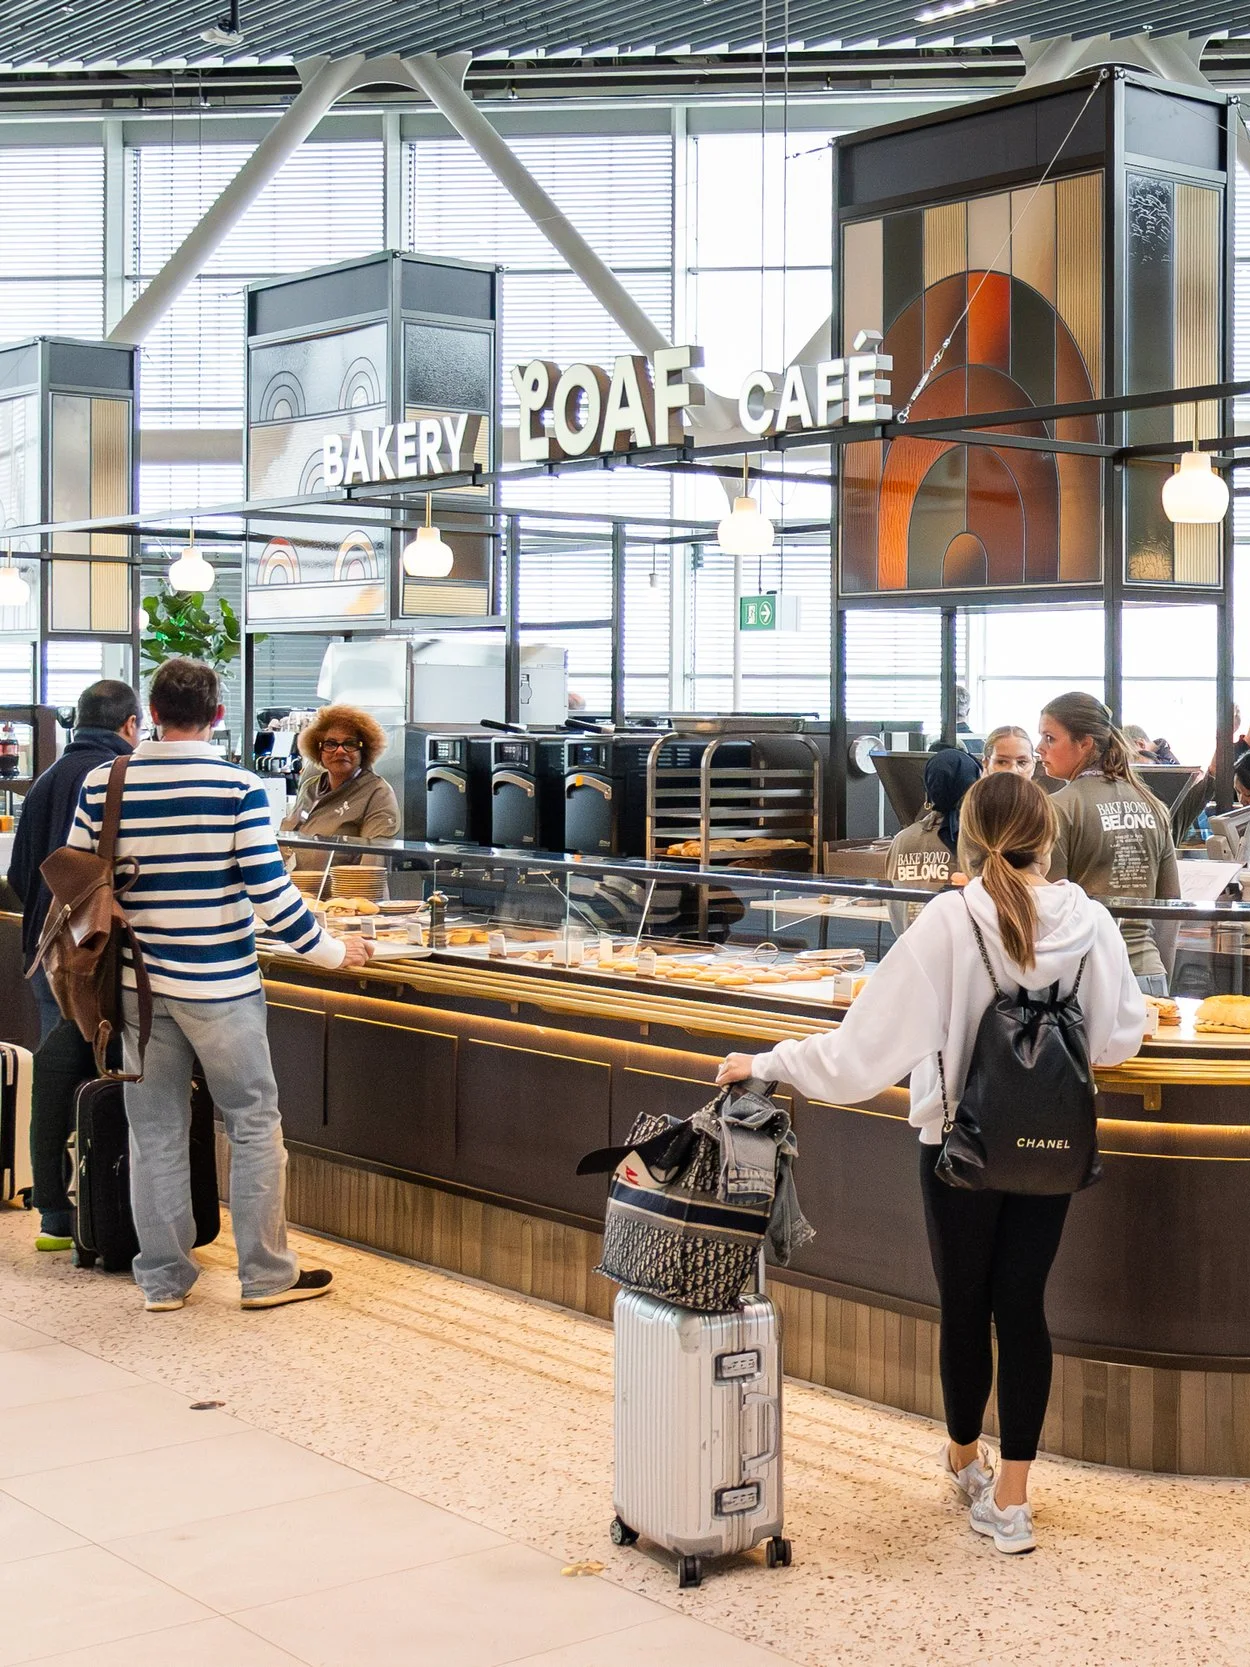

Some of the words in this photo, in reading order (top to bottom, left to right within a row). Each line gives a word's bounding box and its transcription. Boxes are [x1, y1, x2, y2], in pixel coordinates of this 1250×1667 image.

[323, 413, 473, 487] BAKERY
[512, 345, 700, 462] LOAF
[739, 330, 888, 436] CAFÉ
[1096, 802, 1122, 815] BAKE
[1123, 801, 1152, 814] BOND
[1101, 813, 1156, 831] BELONG
[898, 852, 922, 865] BAKE
[922, 851, 950, 864] BOND
[898, 864, 949, 881] BELONG
[1016, 1137, 1071, 1149] CHANEL
